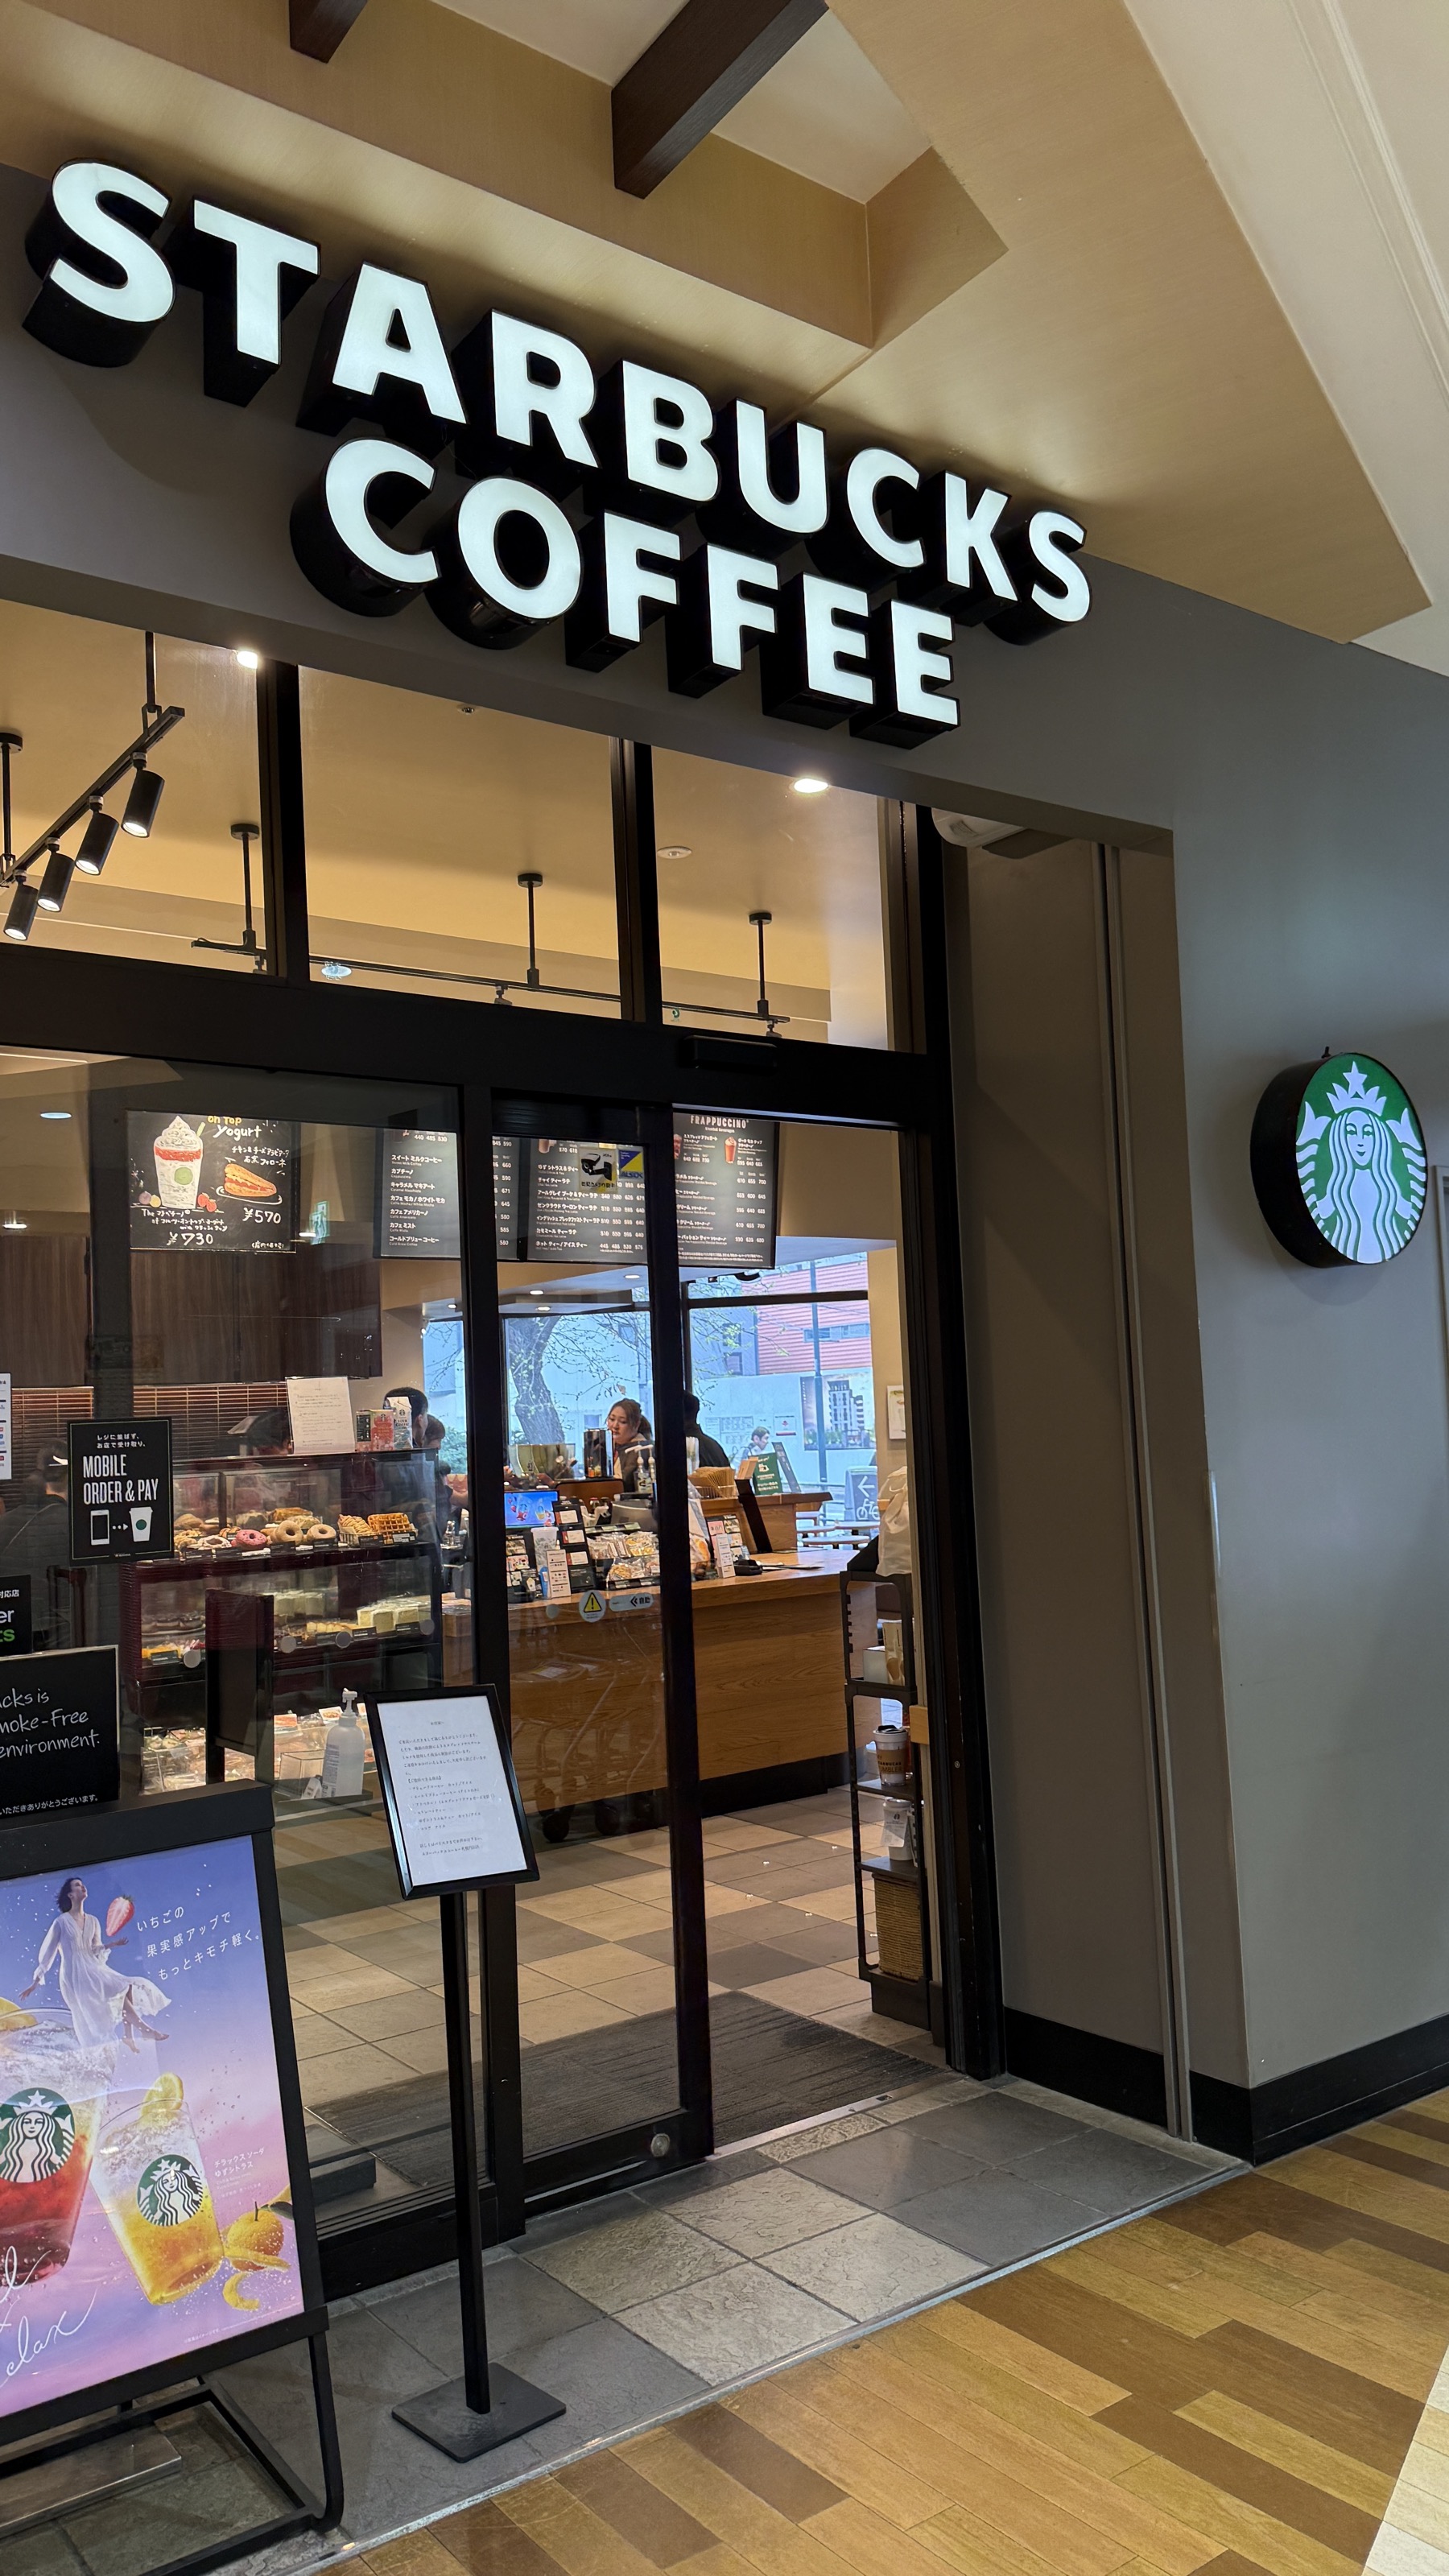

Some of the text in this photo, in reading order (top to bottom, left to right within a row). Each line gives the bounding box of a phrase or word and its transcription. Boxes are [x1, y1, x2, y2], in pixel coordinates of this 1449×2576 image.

[52, 160, 1092, 623] STARBUCKS
[325, 438, 960, 730] COFFEE
[242, 1208, 282, 1224] ¥570
[167, 1232, 213, 1246] ¥730
[83, 1455, 127, 1479] MOBILE
[84, 1478, 159, 1505] ORDER & PAY
[0, 1687, 49, 1709] cks is
[137, 1906, 184, 1932] いちごの
[147, 1911, 231, 1958] 果実感アップで
[158, 1929, 259, 1980] もっとキモチ軽く。
